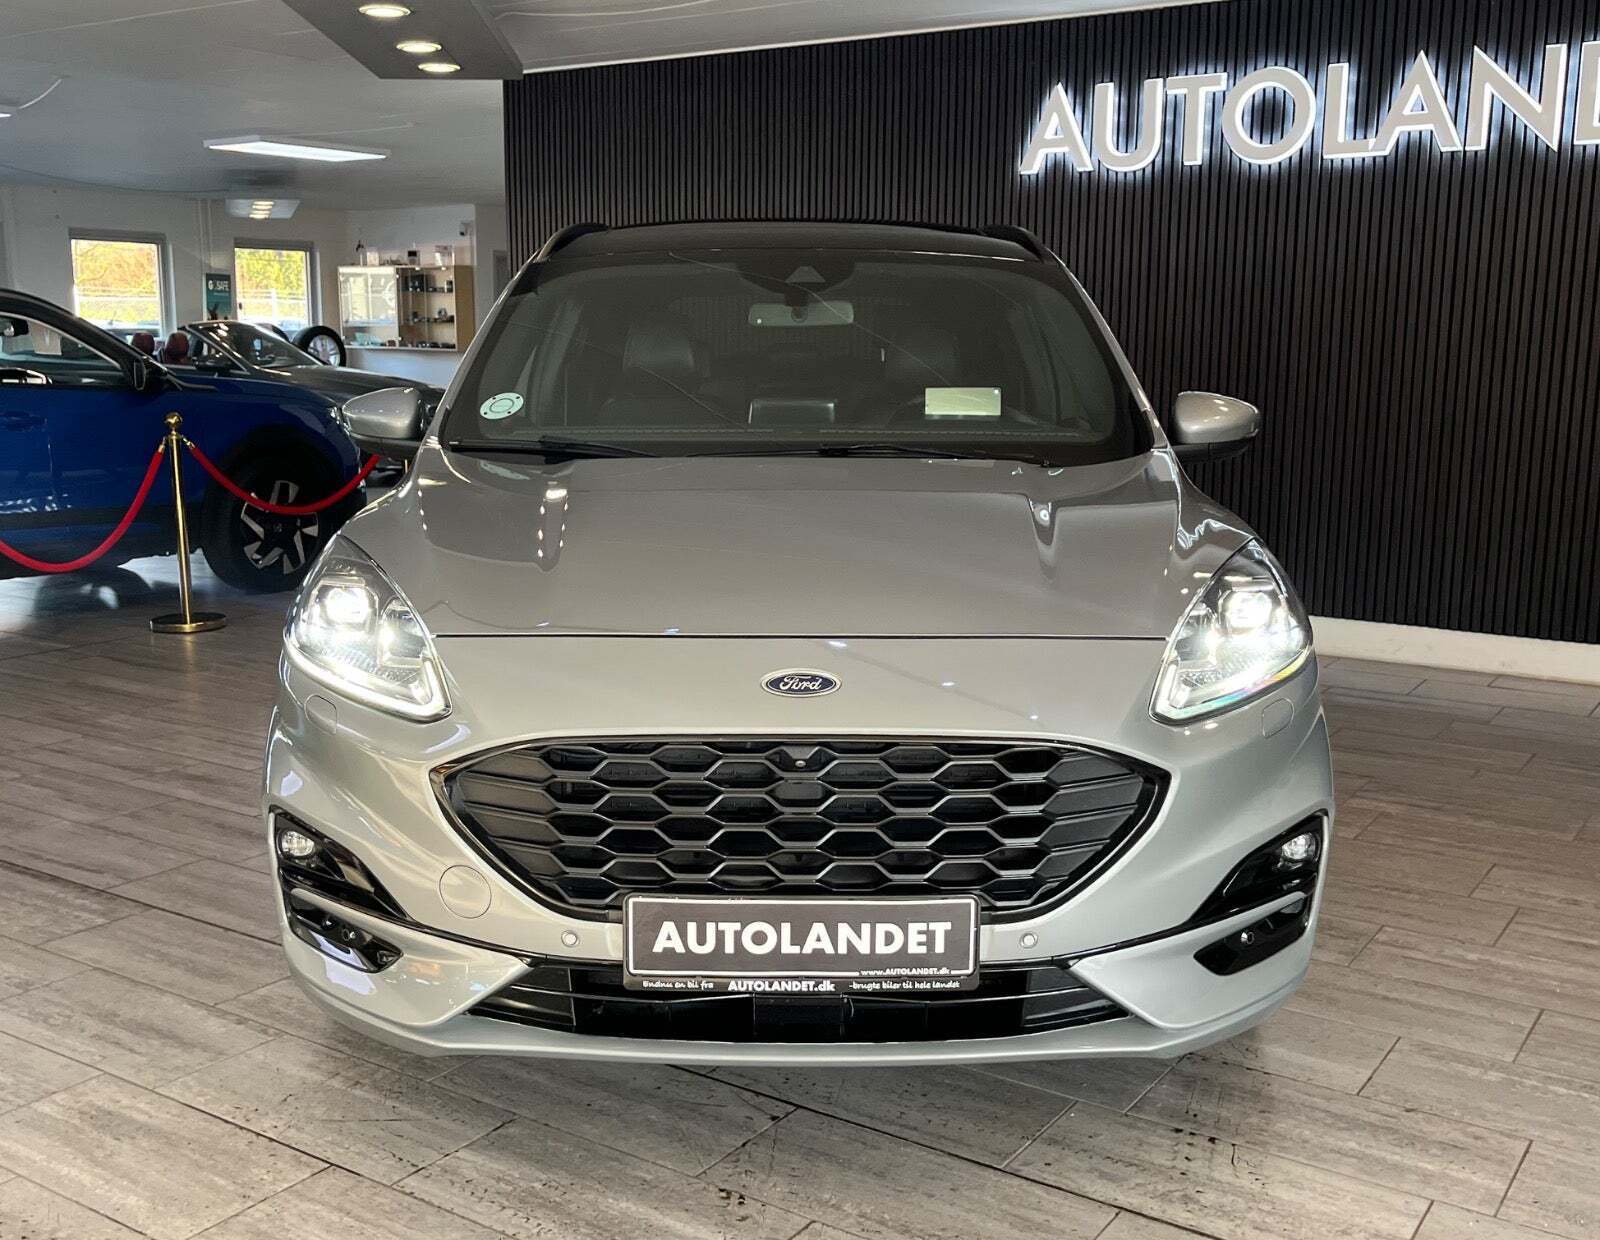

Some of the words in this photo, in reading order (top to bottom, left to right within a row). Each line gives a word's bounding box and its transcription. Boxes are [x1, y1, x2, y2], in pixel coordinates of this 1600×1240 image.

[780, 675, 823, 690] Ford
[652, 920, 952, 955] AUTOLANDET
[861, 967, 950, 976] www.AUTOLANDET.dk
[642, 980, 673, 988] Endnu
[687, 980, 699, 988] bil
[700, 980, 714, 991] fra
[727, 980, 836, 992] AUTOLANDET.dk
[882, 980, 901, 989] biler
[902, 980, 913, 989] til
[914, 980, 931, 989] hele
[932, 980, 959, 988] landet
